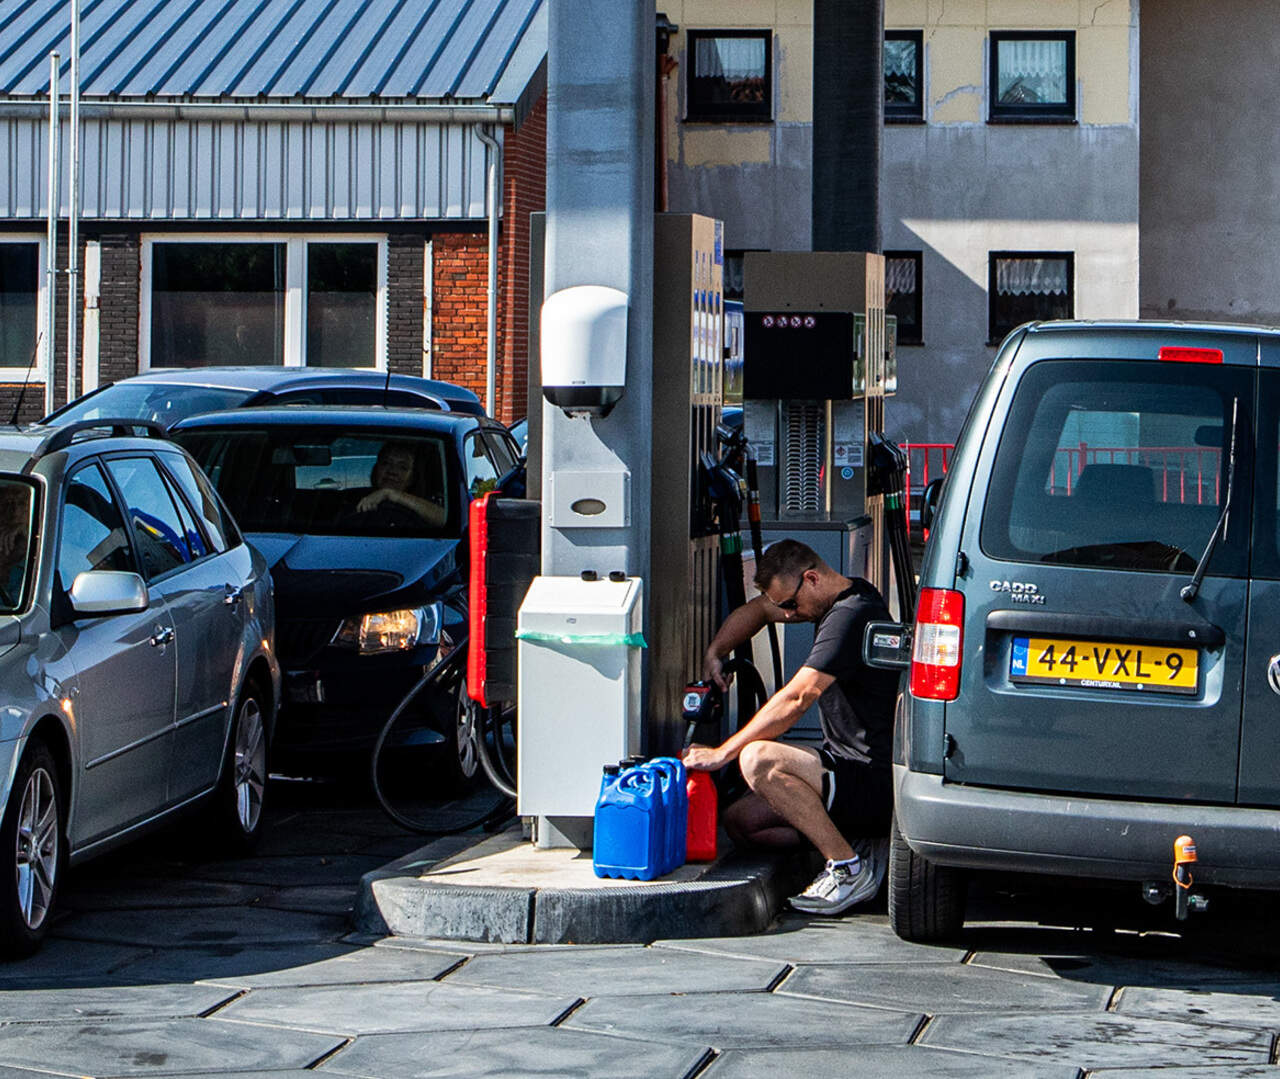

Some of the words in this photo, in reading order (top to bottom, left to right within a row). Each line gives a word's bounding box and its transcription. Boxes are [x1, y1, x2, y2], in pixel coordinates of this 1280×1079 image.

[1011, 593, 1046, 604] MAXI
[1012, 658, 1025, 669] NL
[1038, 644, 1184, 680] 44-VXL-9
